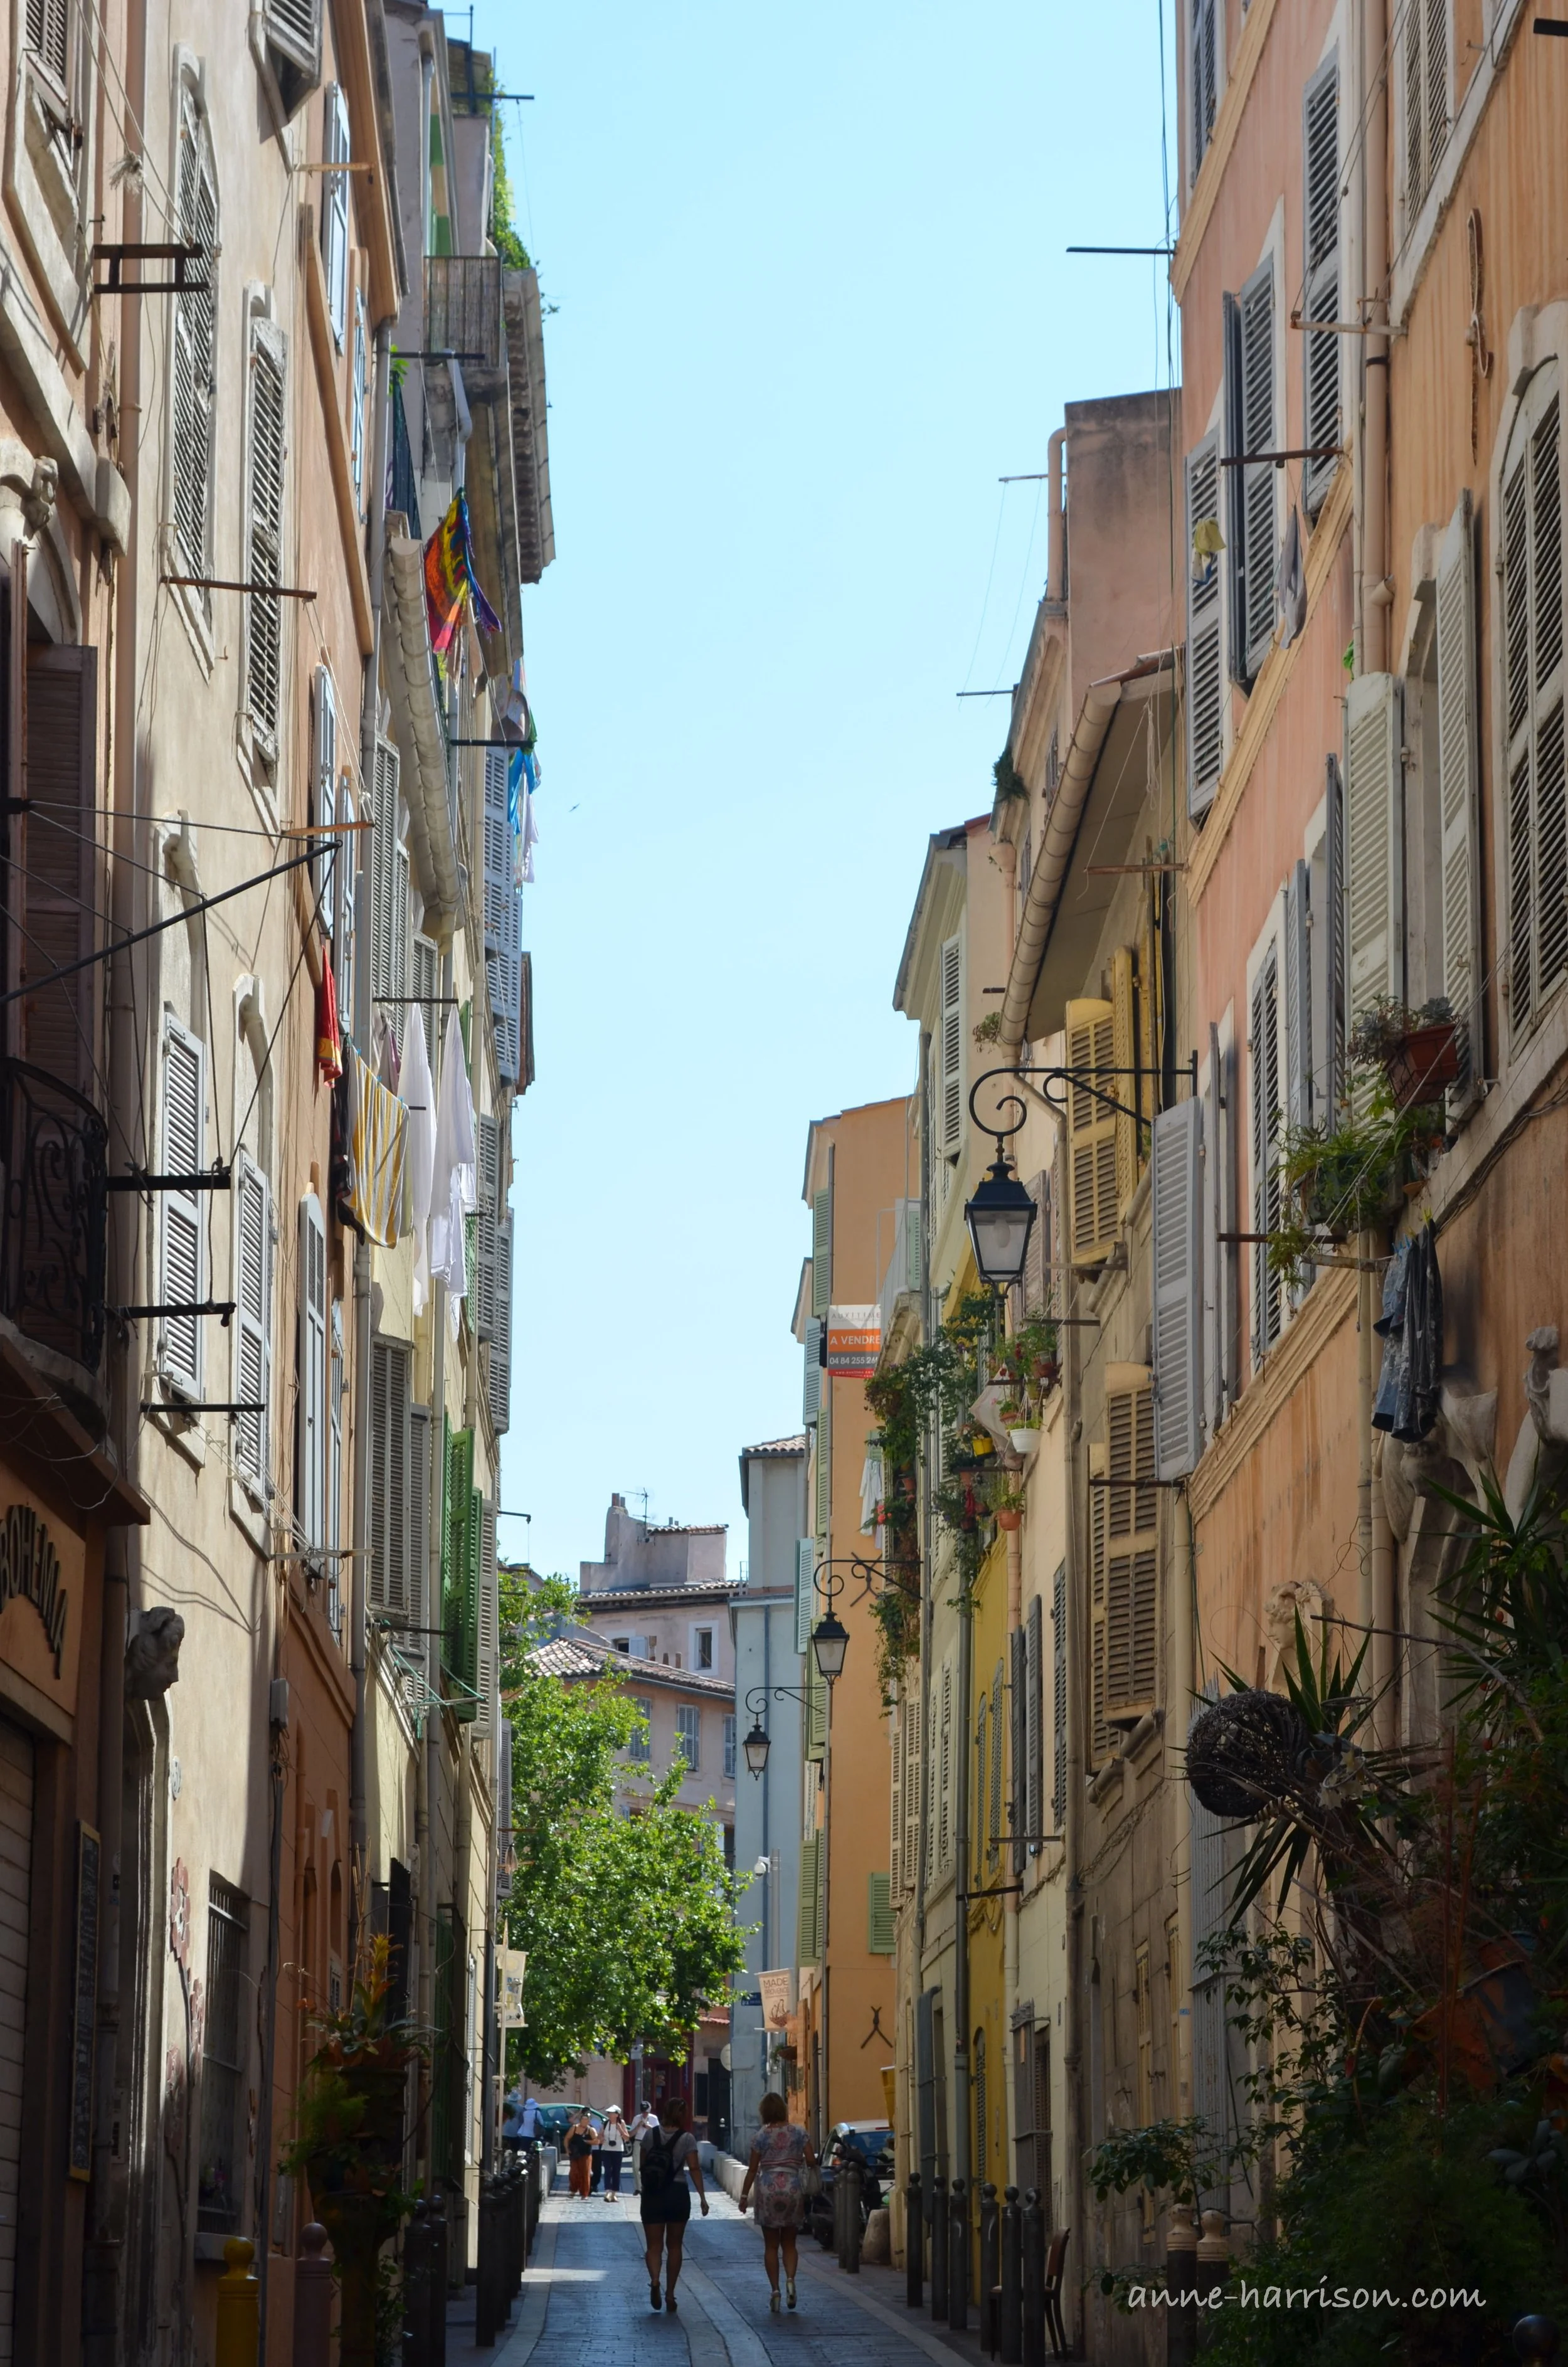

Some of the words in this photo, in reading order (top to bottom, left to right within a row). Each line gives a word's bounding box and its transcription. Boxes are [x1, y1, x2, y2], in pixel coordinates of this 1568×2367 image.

[830, 1337, 837, 1345] A
[840, 1335, 881, 1345] VENDRE
[763, 1977, 788, 1988] MADE
